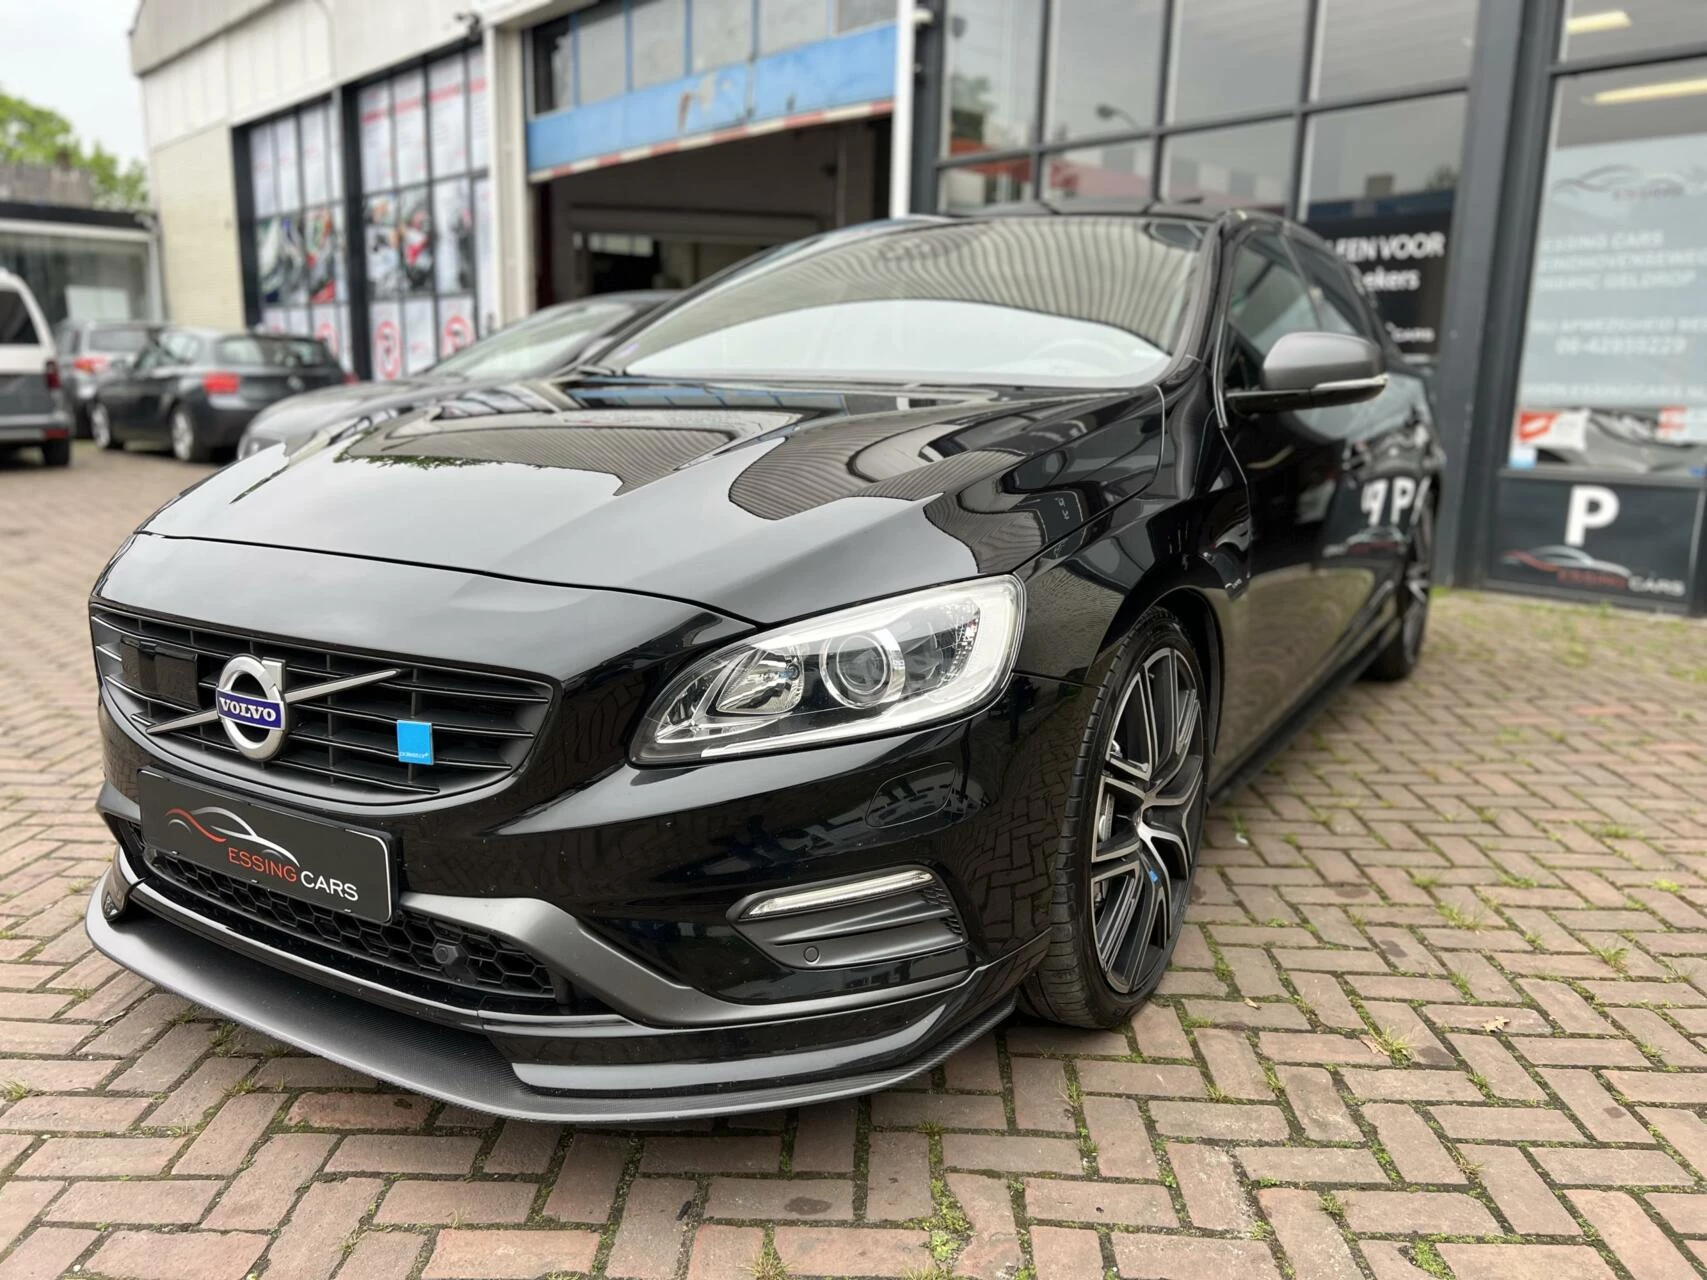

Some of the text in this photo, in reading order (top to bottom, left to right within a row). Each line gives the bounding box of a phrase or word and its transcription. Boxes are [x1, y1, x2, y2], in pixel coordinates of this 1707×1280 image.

[1379, 231, 1445, 260] VOOR
[1611, 229, 1664, 249] CARS
[1566, 485, 1620, 547] P
[1628, 576, 1686, 597] CARS
[219, 697, 276, 721] VOLVO
[228, 847, 359, 901] ESSING CARS
